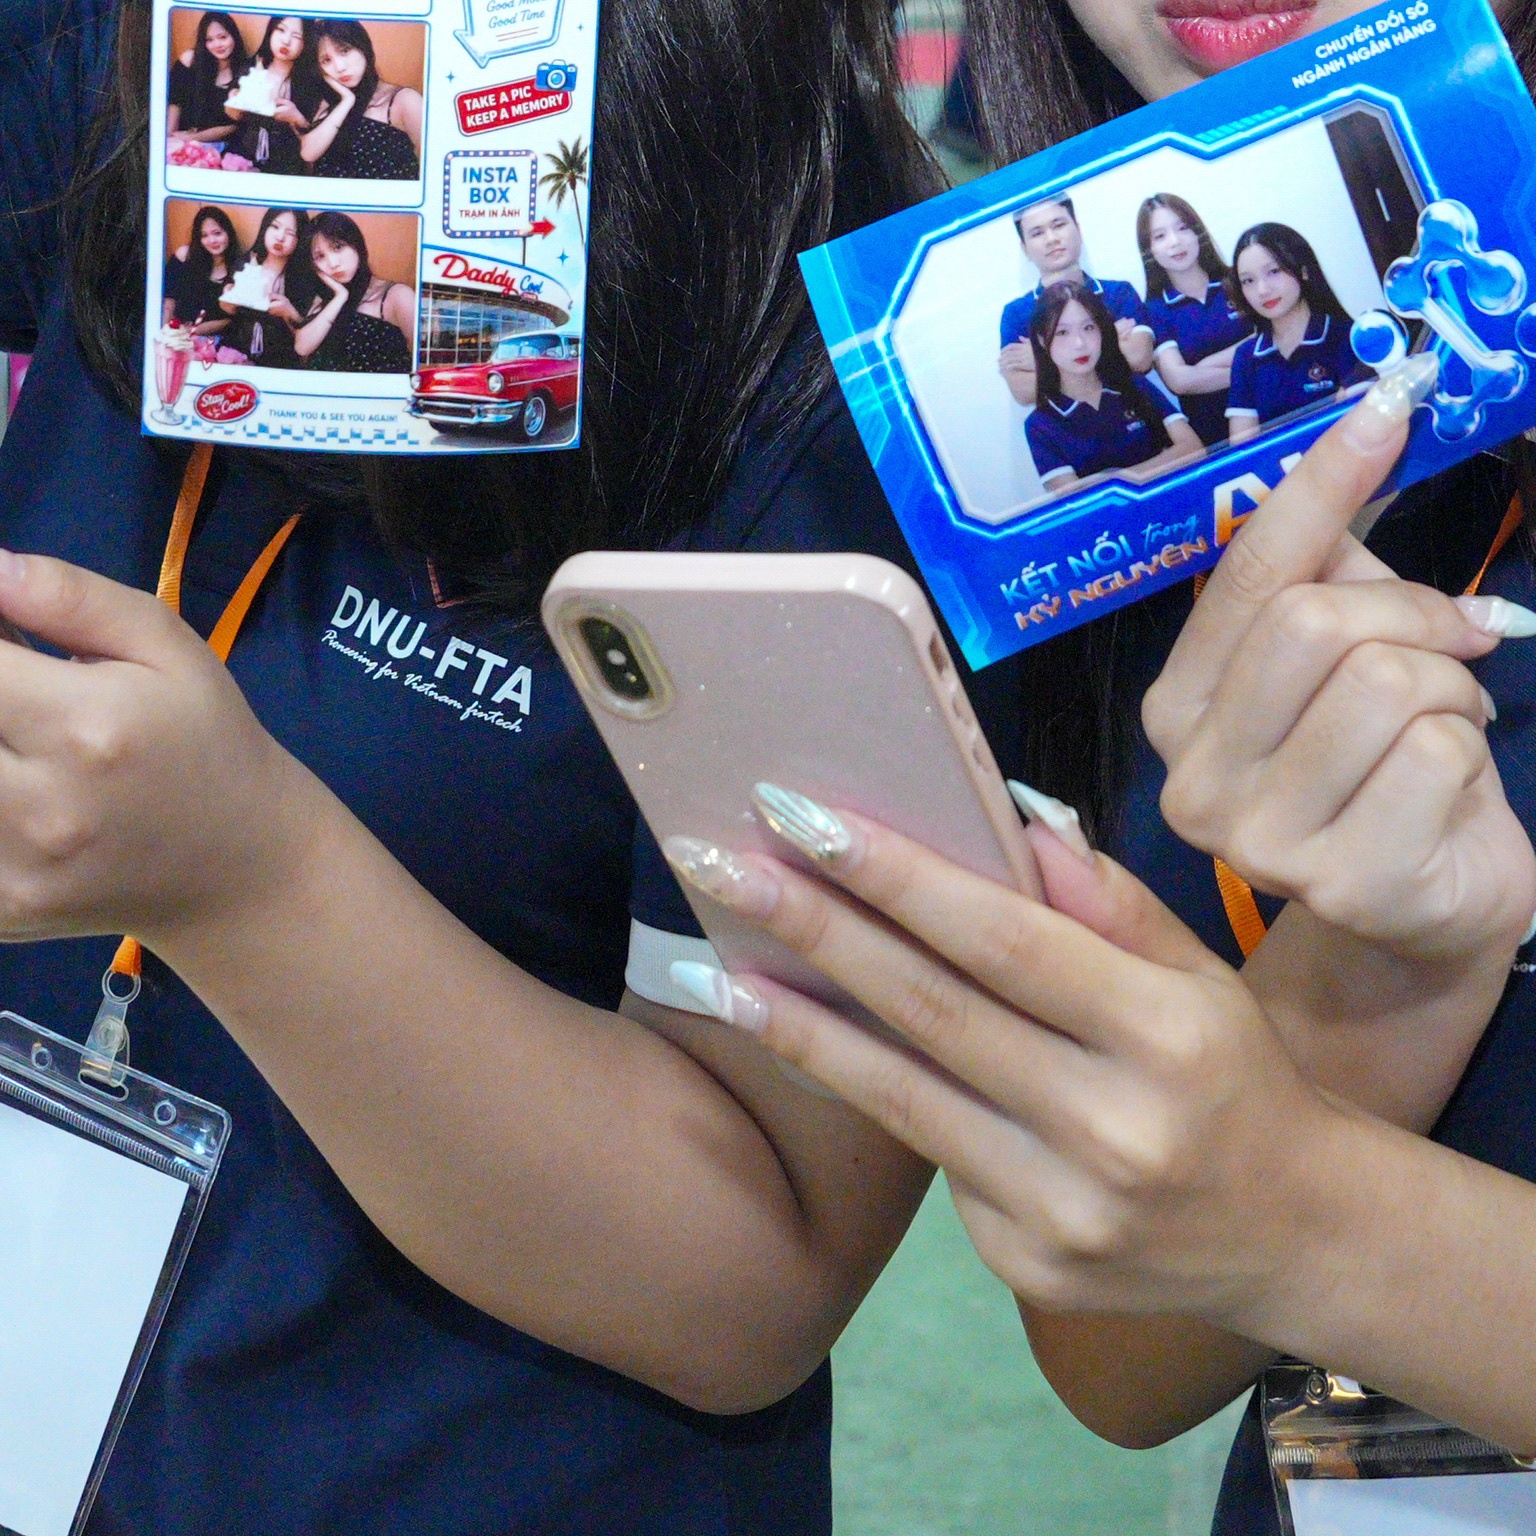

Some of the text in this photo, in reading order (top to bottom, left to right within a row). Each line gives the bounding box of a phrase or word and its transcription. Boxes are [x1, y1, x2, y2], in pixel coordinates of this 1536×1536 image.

[488, 9, 546, 29] Good Time
[1291, 18, 1437, 89] NGÀNH NGÂN HÀNG
[464, 85, 532, 111] TAKE A PIC
[466, 92, 564, 128] KEEP A MEMORY
[462, 166, 518, 183] INSTA
[469, 187, 511, 203] BOX
[488, 209, 498, 218] IN
[433, 254, 543, 297] Daddy Cool
[201, 392, 250, 414] Stay Cool!
[269, 408, 297, 419] THANK
[300, 411, 318, 420] YOU
[330, 412, 345, 421] SEE
[347, 413, 365, 422] YOU
[368, 414, 398, 423] AGAIN!
[1000, 514, 1199, 606] KẾT NỐI trong
[1068, 536, 1208, 608] NGUYÊN
[330, 584, 533, 715] DNU-FTA
[321, 629, 522, 733] Pioneering for Vietnam fintech
